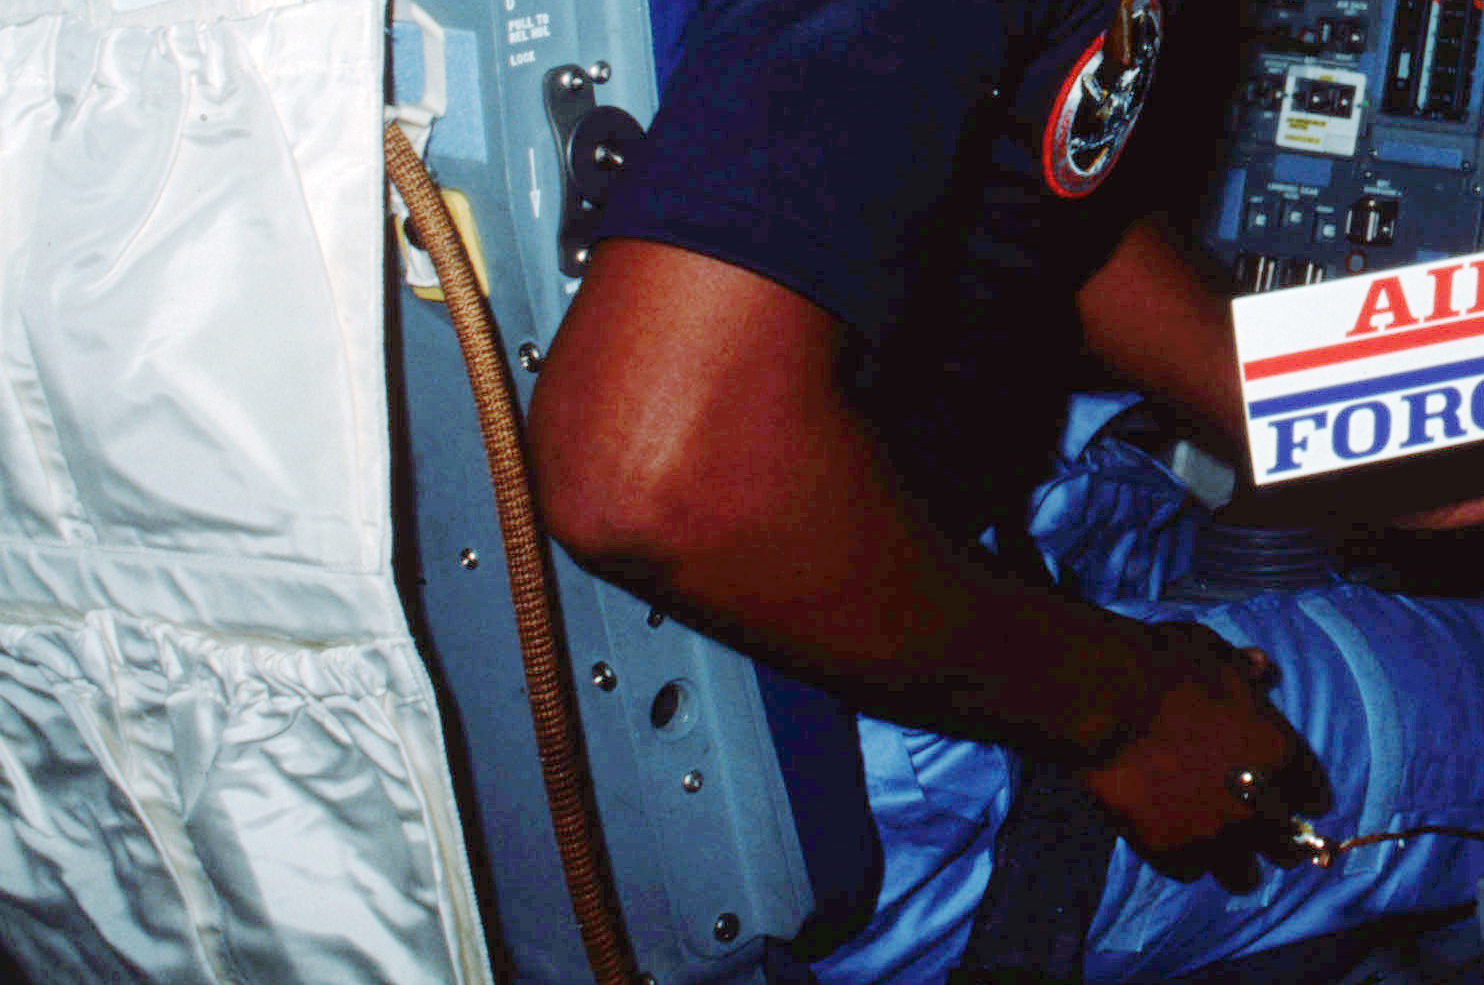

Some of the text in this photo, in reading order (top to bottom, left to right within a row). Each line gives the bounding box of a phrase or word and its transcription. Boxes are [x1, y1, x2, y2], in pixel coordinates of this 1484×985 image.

[508, 12, 550, 32] PULL TO
[510, 51, 536, 67] LOCK
